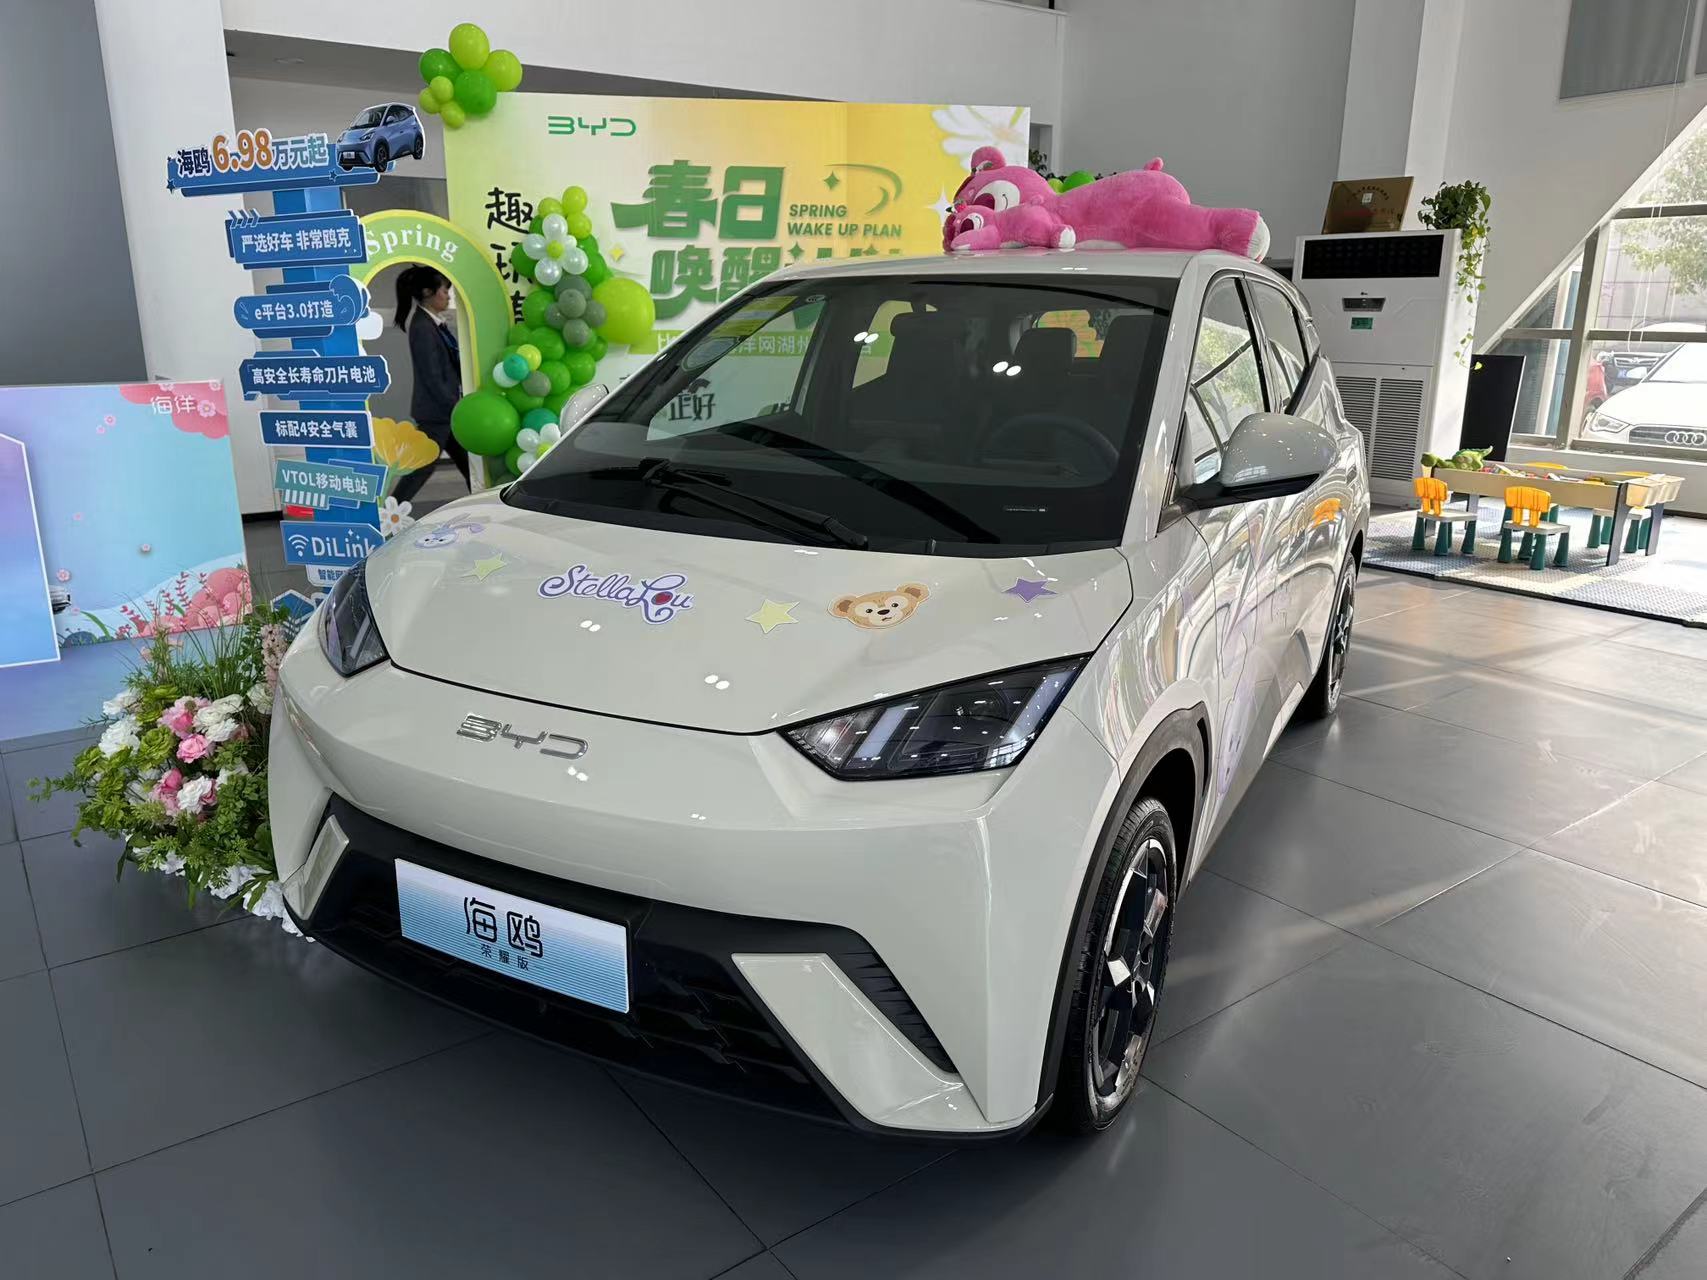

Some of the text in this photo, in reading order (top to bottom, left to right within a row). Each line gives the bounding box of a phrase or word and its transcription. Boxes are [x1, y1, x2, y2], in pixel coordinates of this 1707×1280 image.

[547, 115, 637, 137] BYD
[610, 159, 786, 240] 春日
[789, 204, 847, 218] SPRING
[241, 226, 351, 253] 严选好车 非常鸥克
[787, 222, 903, 238] WAKE UP PLAN
[366, 223, 459, 263] Spring
[254, 299, 335, 321] e平台3.0打造
[251, 364, 377, 386] 高安全长寿命刀片电池
[151, 393, 198, 416] 海洋
[275, 419, 358, 439] 标配4安全气囊
[281, 469, 368, 495] VTOL移动电站
[311, 535, 376, 559] DiLink
[456, 712, 589, 760] BYD
[463, 896, 544, 959] 海鸥
[480, 942, 530, 972] 荣耀版
